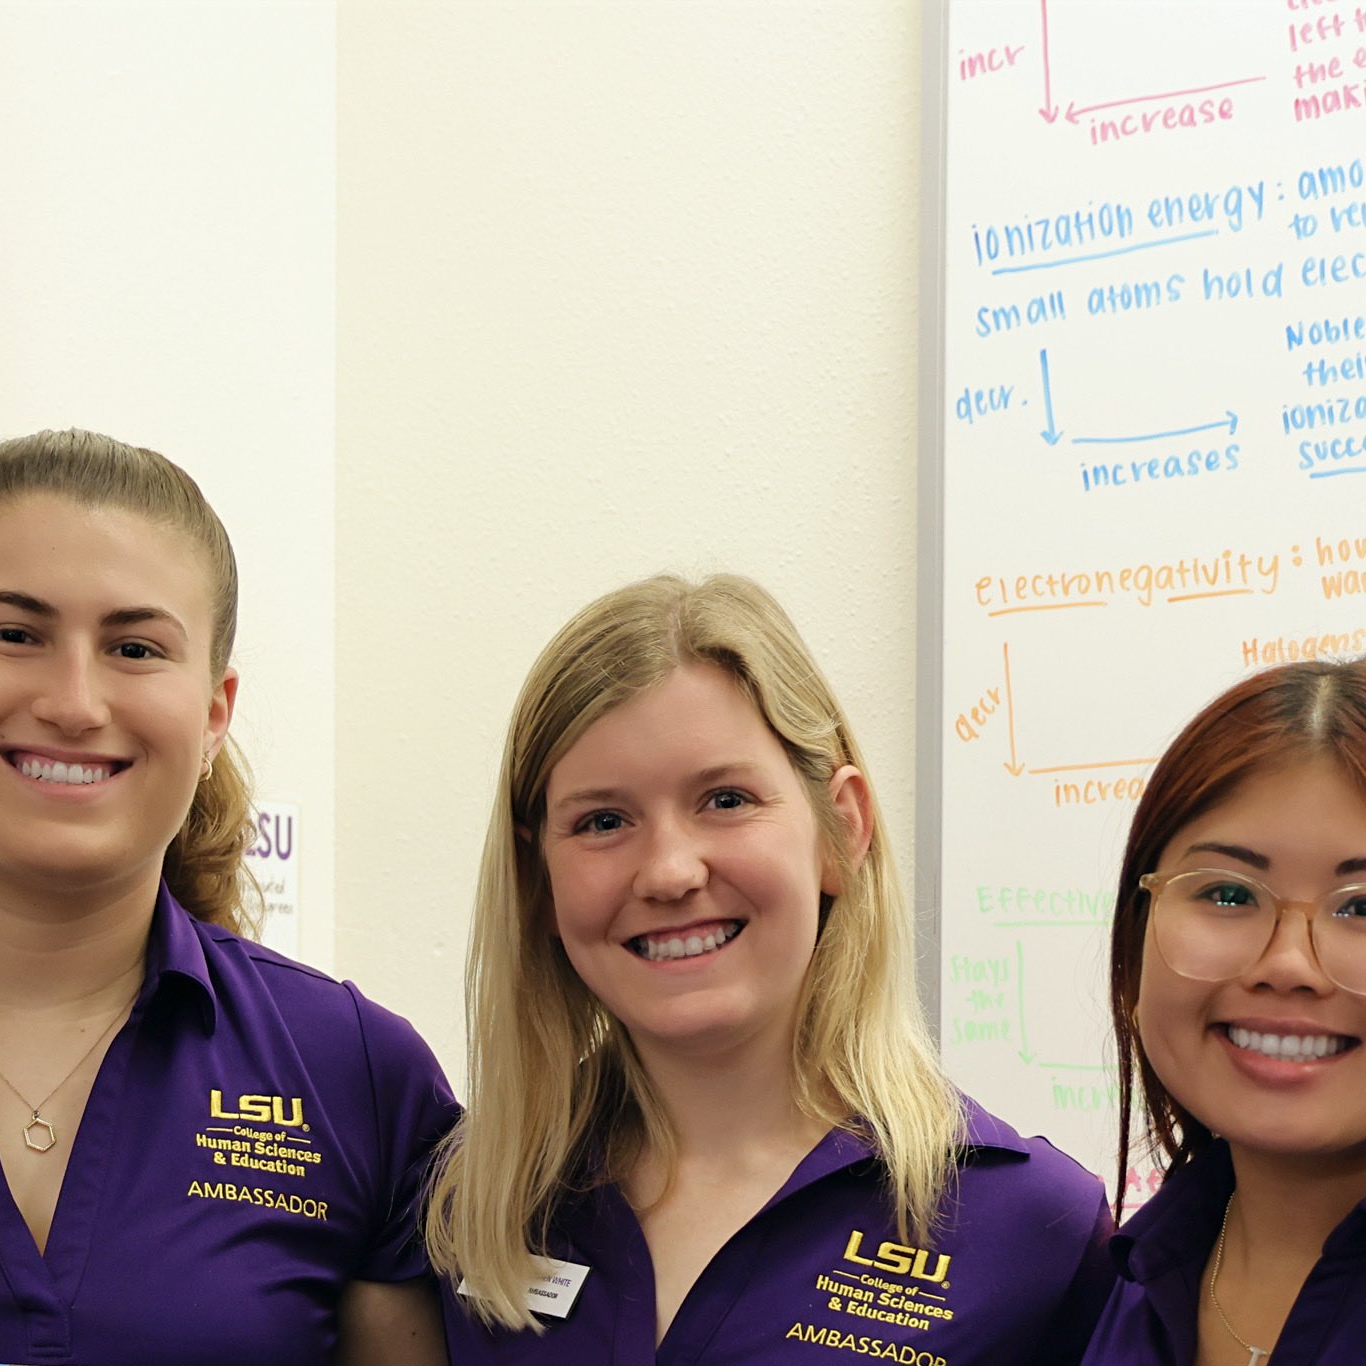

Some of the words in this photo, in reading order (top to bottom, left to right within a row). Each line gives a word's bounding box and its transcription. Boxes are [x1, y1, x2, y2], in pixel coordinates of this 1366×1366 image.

[1289, 13, 1345, 52] left
[959, 44, 1025, 81] incr
[1293, 56, 1344, 89] the
[1090, 98, 1234, 146] increase
[971, 200, 1134, 267] ionization
[1288, 212, 1318, 240] to
[976, 291, 1066, 337] small
[1087, 273, 1185, 315] atoms
[1203, 261, 1283, 301] hold
[1286, 316, 1365, 351] Noble
[1080, 443, 1240, 491] increases
[246, 812, 292, 861] SU
[210, 1089, 304, 1127] LSU
[196, 1134, 251, 1153] Human
[254, 1143, 322, 1164] Sciences
[234, 1126, 273, 1142] College
[275, 1132, 287, 1142] of
[213, 1151, 227, 1165] &
[231, 1153, 306, 1177] Education
[187, 1180, 328, 1221] AMBASSADOR
[843, 1230, 952, 1283] LSU
[816, 1274, 875, 1303] Human
[877, 1290, 954, 1321] Sciences
[860, 1274, 904, 1294] College
[905, 1286, 919, 1296] of
[828, 1297, 842, 1311] &
[846, 1302, 930, 1331] Education
